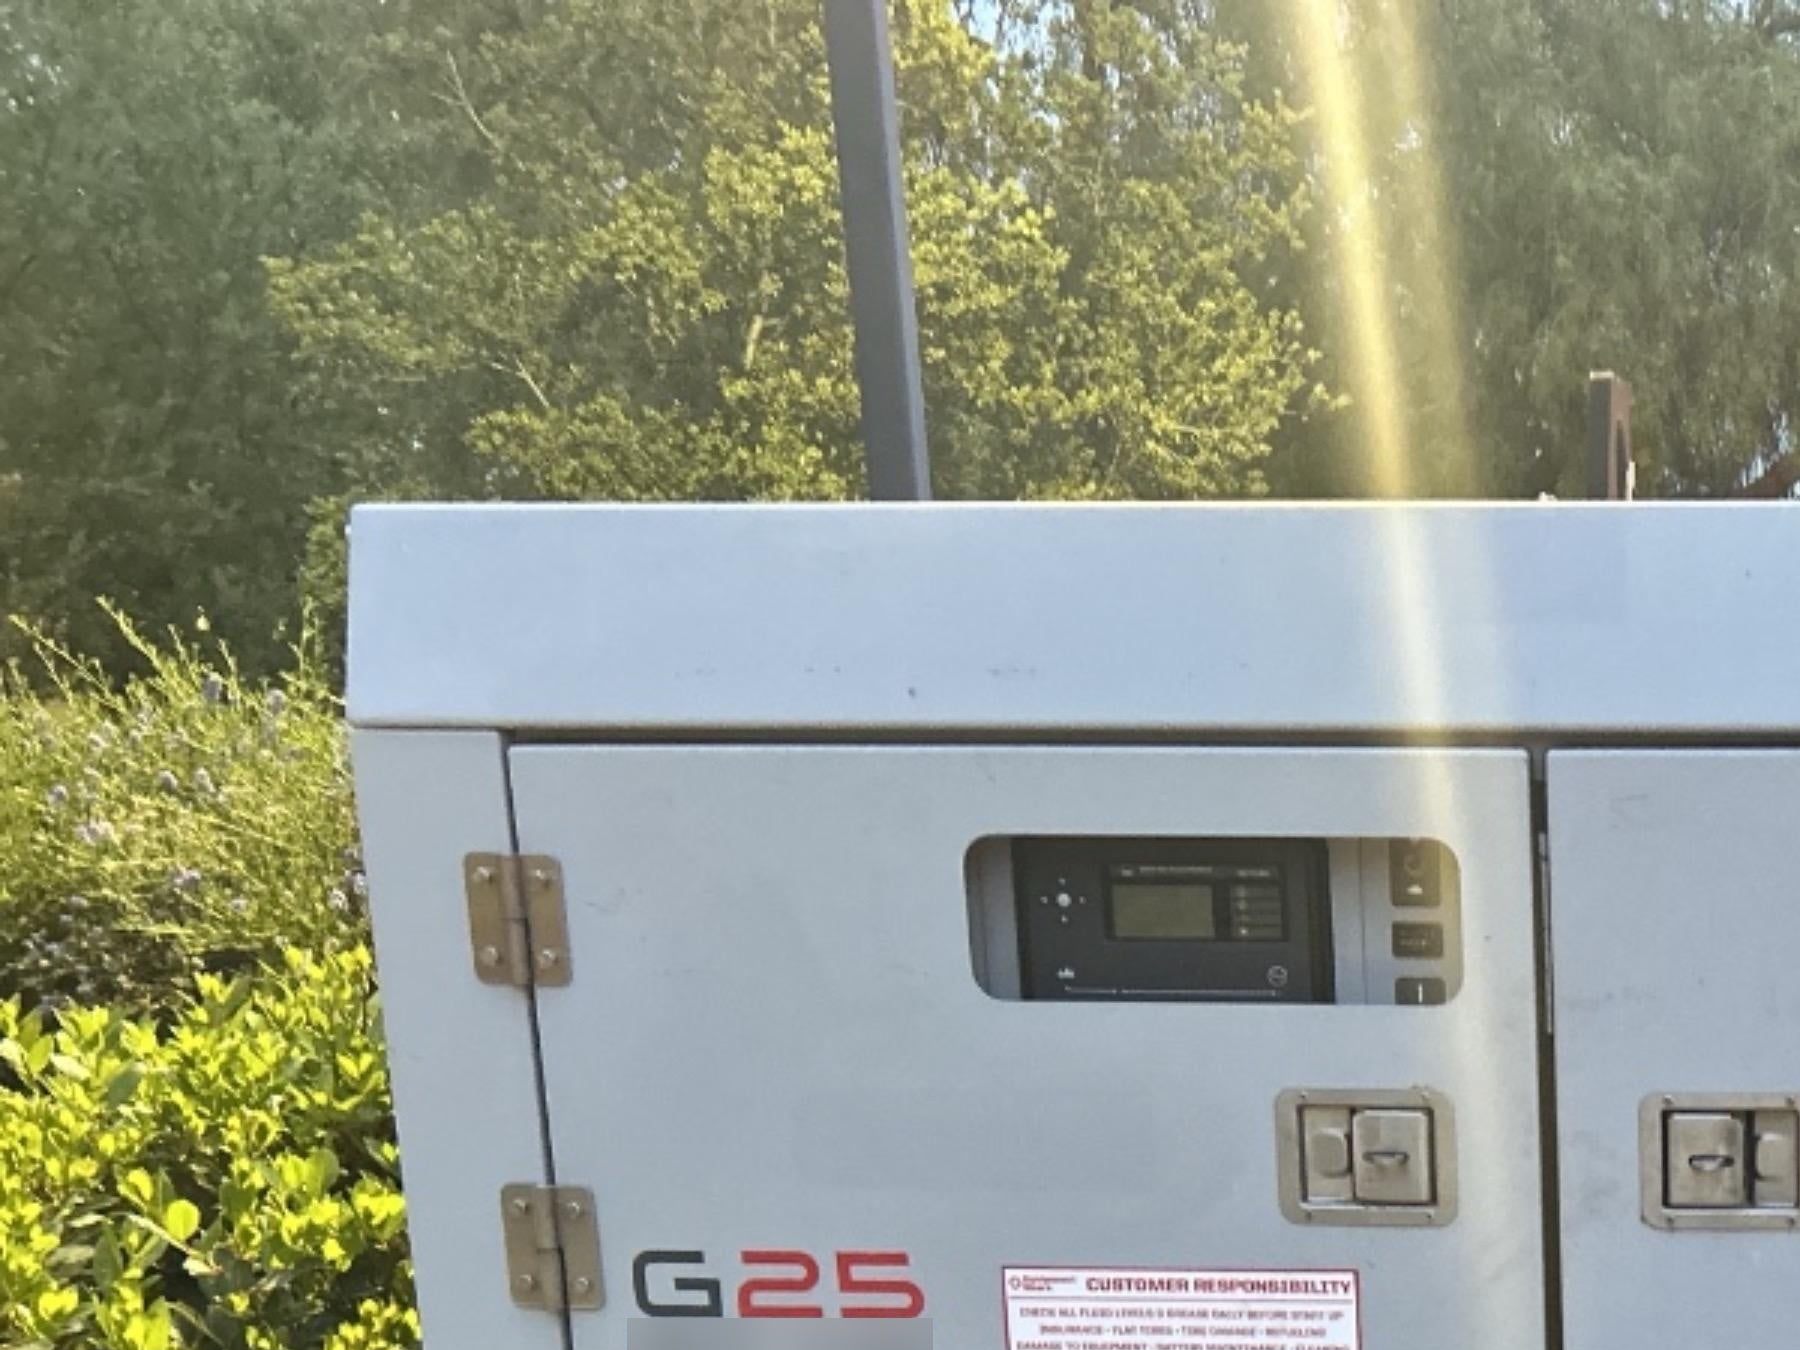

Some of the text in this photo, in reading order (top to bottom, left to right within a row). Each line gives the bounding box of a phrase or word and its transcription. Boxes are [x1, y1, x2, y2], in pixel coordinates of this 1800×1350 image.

[632, 1249, 926, 1319] G25
[1085, 1276, 1189, 1293] CUSTOMER
[1193, 1277, 1351, 1295] RESPONSIBILITY
